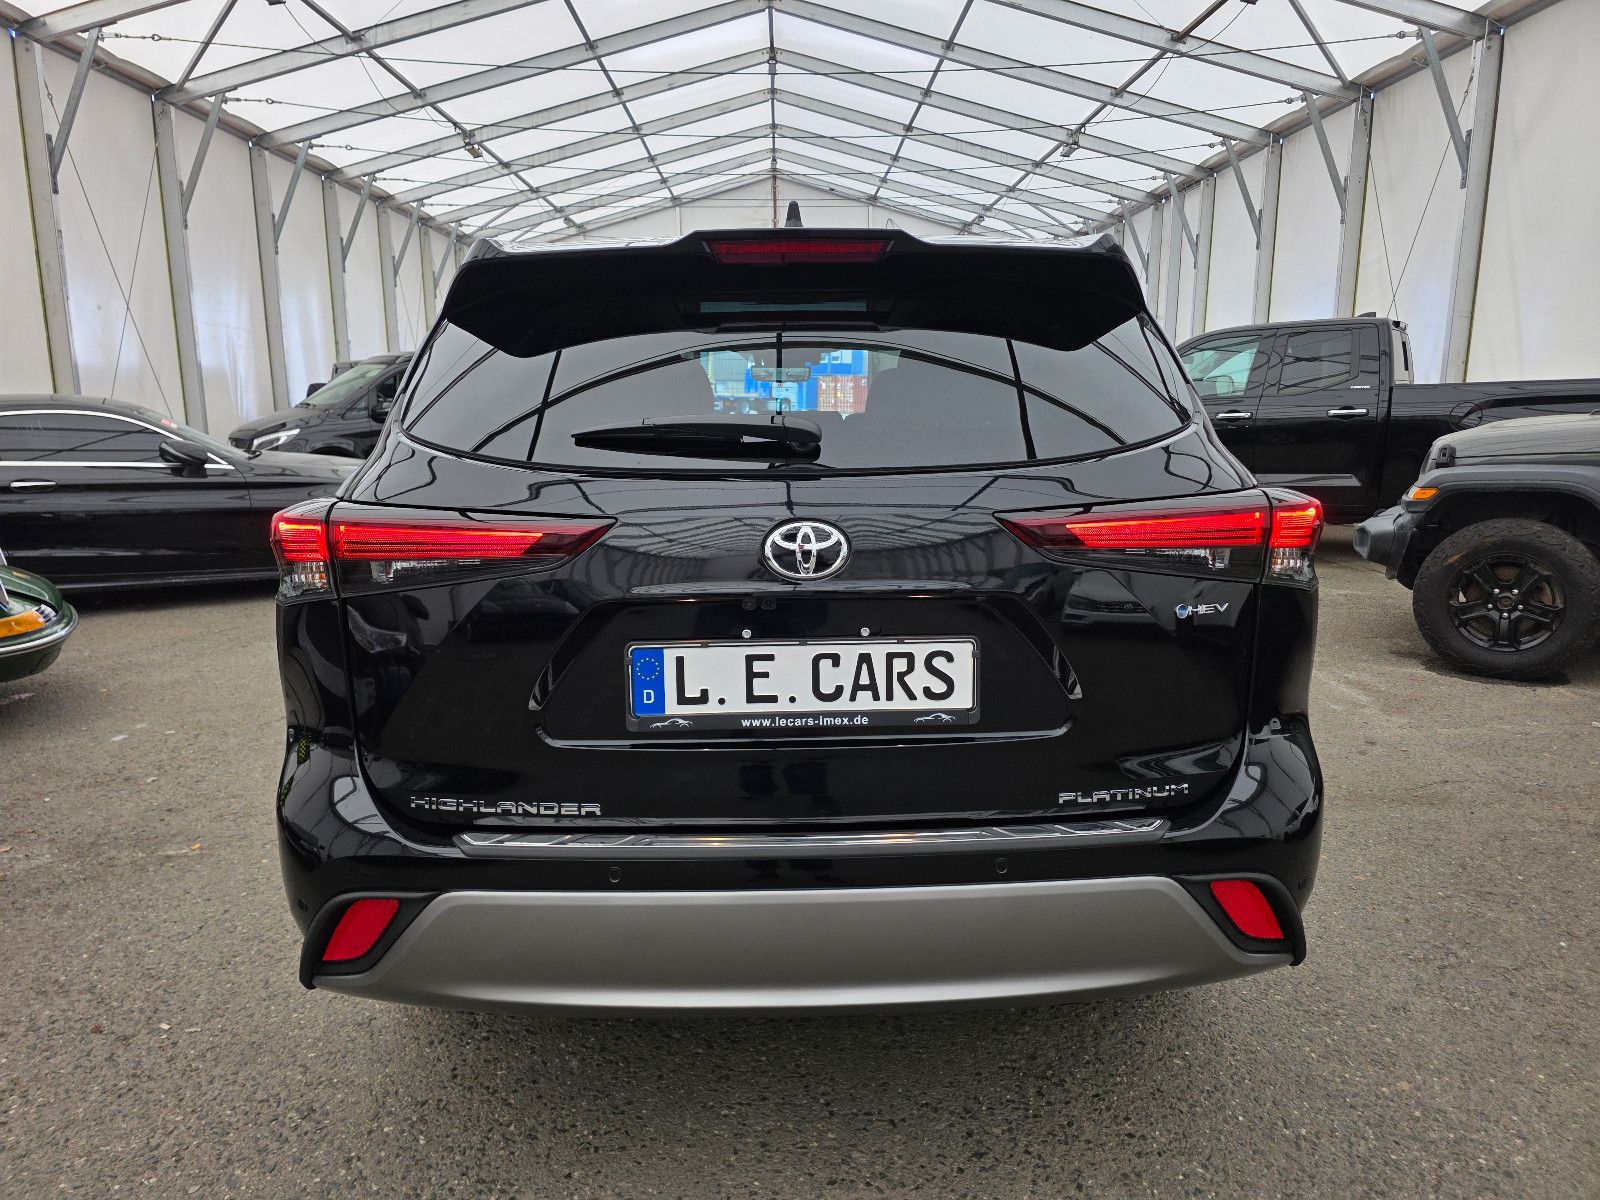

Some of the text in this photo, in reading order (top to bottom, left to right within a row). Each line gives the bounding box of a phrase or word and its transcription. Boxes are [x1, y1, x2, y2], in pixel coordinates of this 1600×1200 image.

[811, 650, 955, 702] CARS
[643, 689, 655, 704] D
[741, 715, 869, 727] www.lecars-imex.de
[1058, 783, 1189, 804] PLATINUM
[410, 796, 601, 816] HIGHLANDER
